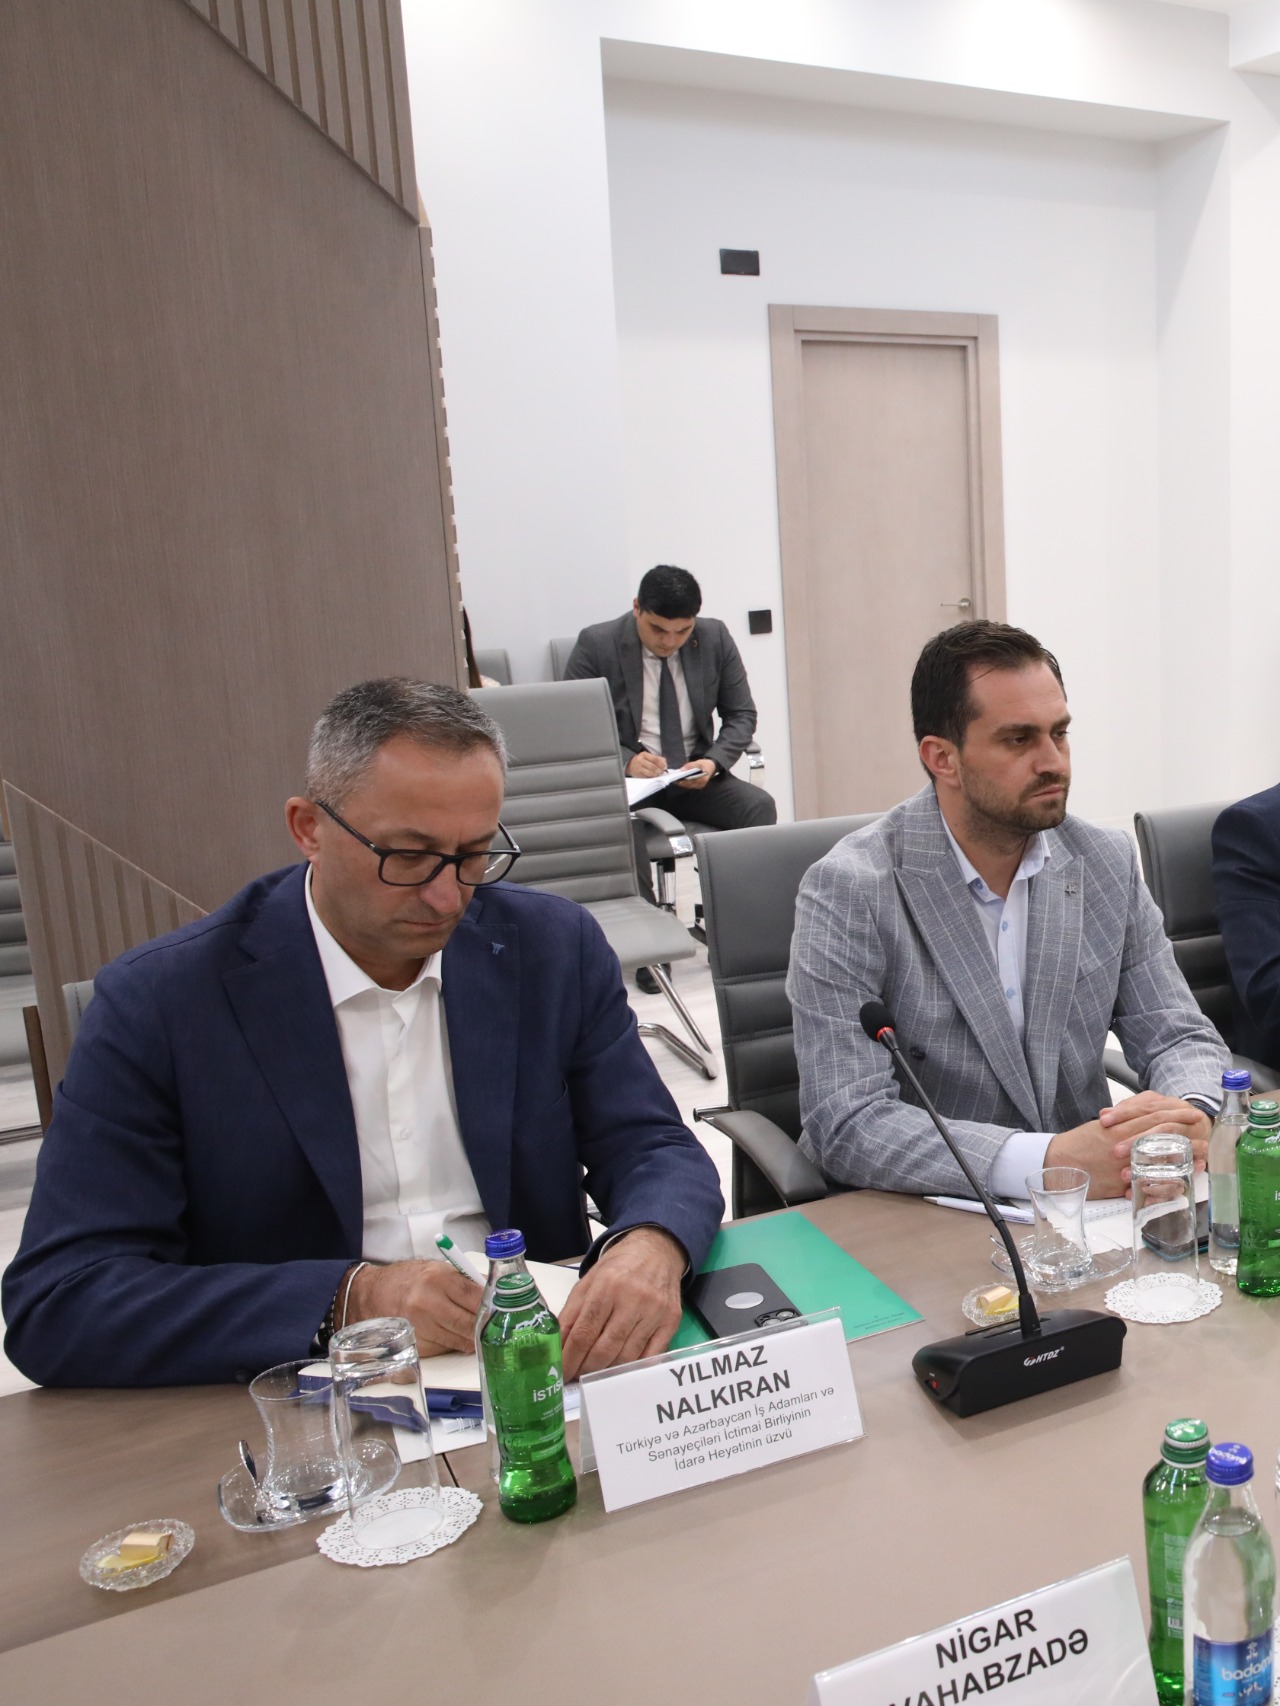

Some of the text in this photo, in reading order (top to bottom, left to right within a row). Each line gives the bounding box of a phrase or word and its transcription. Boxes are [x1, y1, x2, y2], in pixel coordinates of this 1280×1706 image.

[670, 1345, 768, 1387] YILMAZ
[616, 1386, 835, 1455] Türkiyə və Azərbaycan İş Adamları və
[656, 1370, 791, 1424] NALKIRAN
[648, 1408, 811, 1463] Sənayeçiləri İctimai Birliyinin
[674, 1429, 793, 1471] İdarə Heyətinin üzvü
[935, 1608, 1038, 1669] NİGAR
[888, 1628, 1089, 1706] AHABZADƏ
